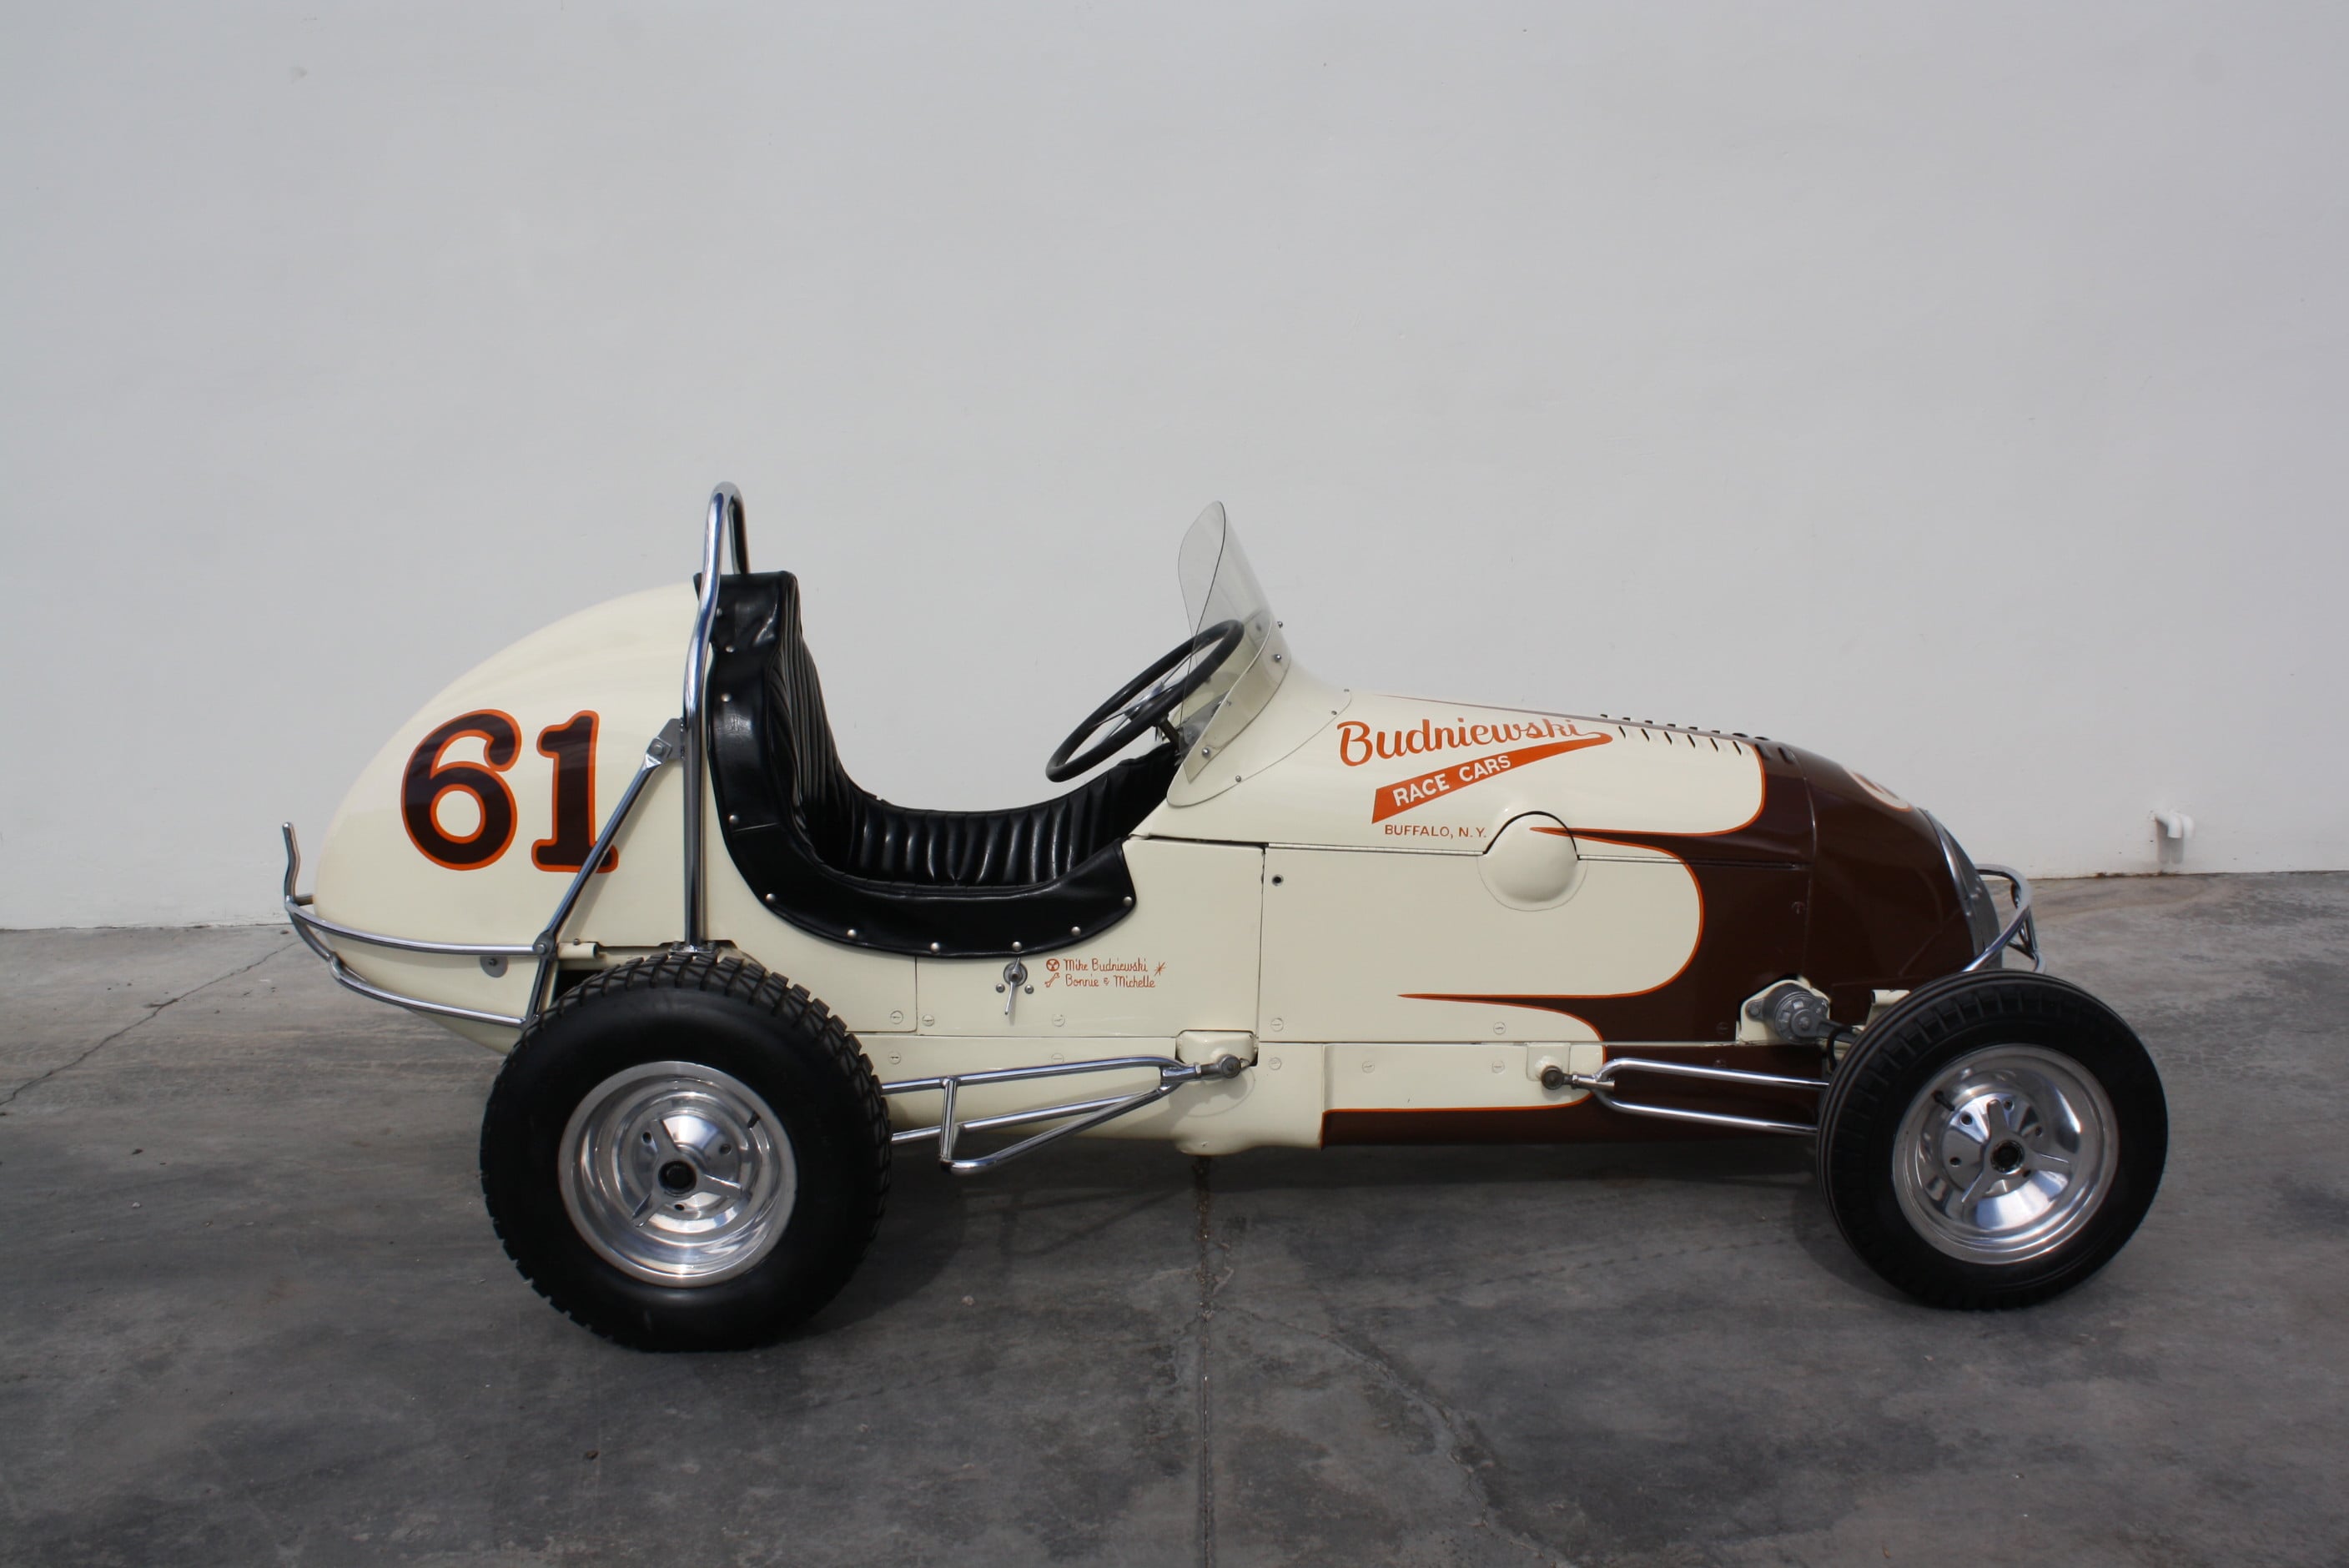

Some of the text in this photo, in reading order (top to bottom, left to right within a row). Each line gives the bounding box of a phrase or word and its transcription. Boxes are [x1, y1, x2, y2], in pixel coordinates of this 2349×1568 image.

[1336, 717, 1585, 766] Budniewski
[400, 709, 619, 873] 61
[1392, 755, 1512, 807] RACE CARS
[1385, 824, 1454, 839] BUFFALO,
[1064, 957, 1148, 972] Mike Budniewski
[1065, 973, 1099, 988] Bonnie
[1114, 974, 1155, 988] Michelle
